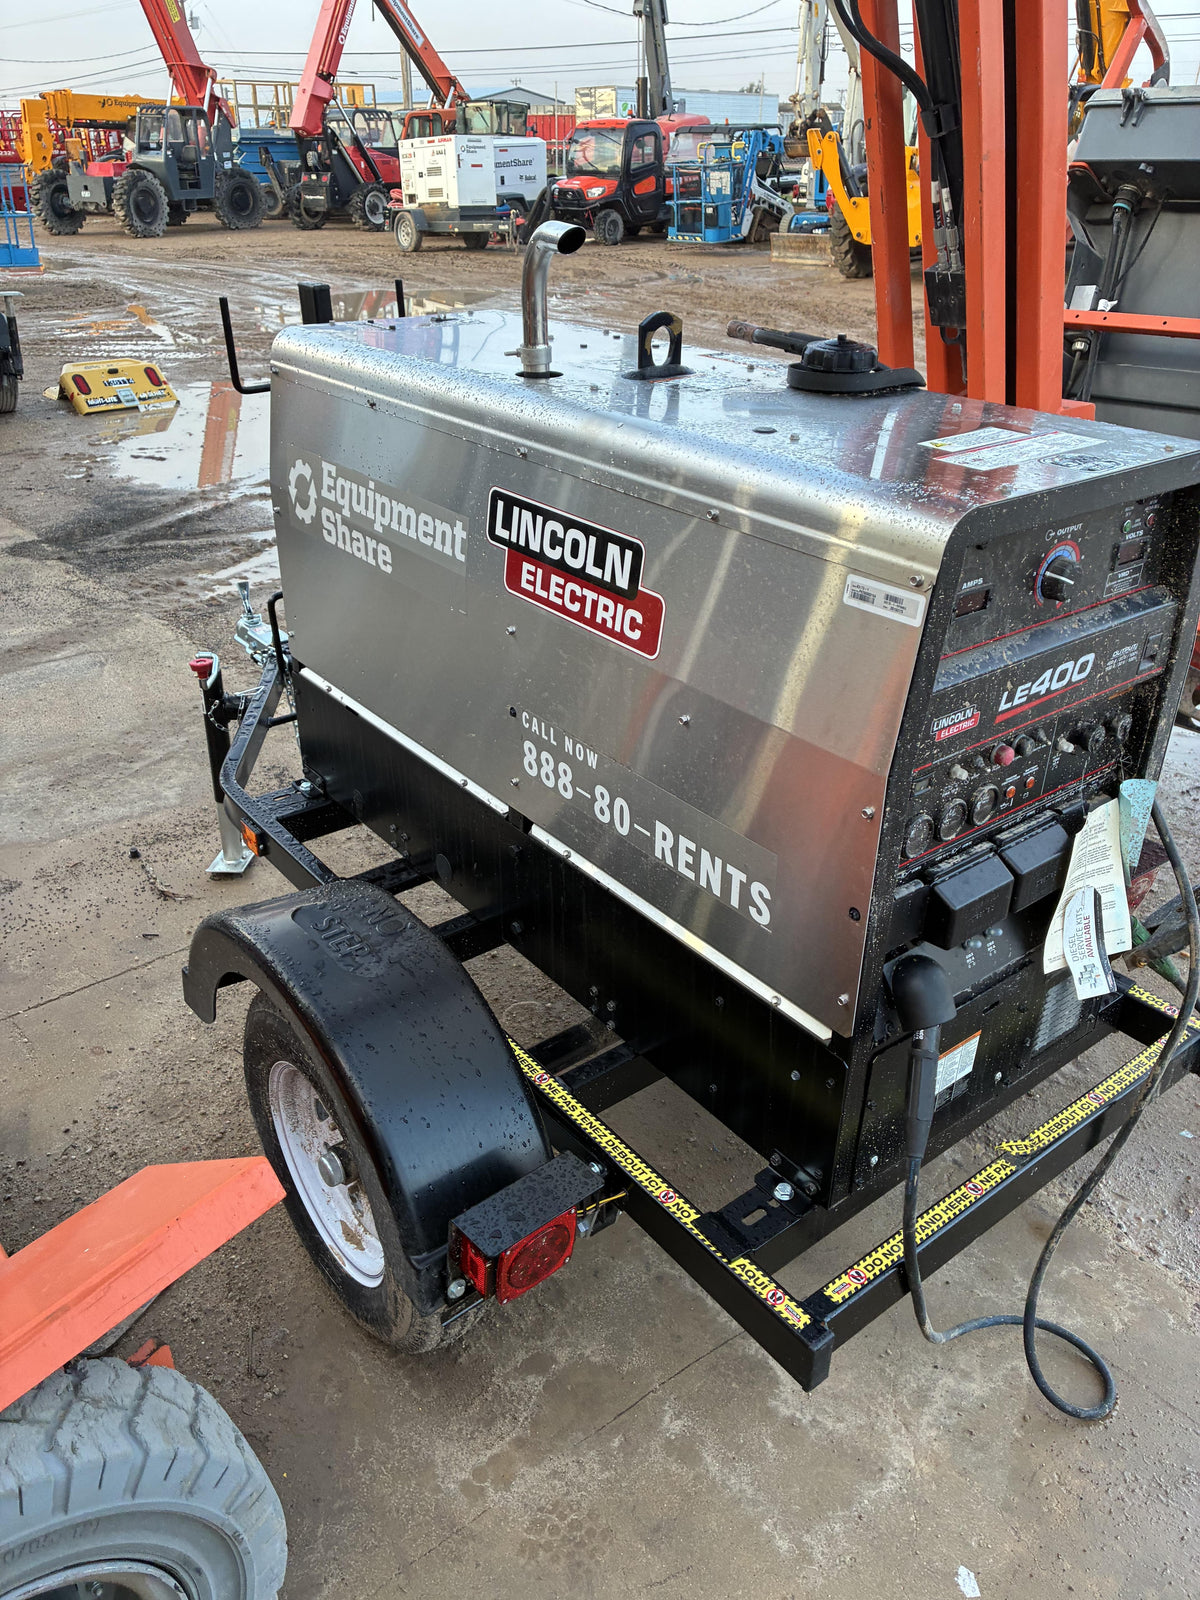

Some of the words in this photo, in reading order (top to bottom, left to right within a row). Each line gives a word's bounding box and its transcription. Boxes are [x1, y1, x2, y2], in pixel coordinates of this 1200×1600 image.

[321, 460, 467, 563] Equipment
[1057, 523, 1083, 536] OUTPUT
[321, 506, 393, 574] Share
[495, 499, 633, 590] LINCOLN
[1125, 529, 1143, 540] VOLTS
[520, 561, 643, 640] ELECTRIC
[961, 577, 984, 590] AMPS
[998, 653, 1096, 712] LE400
[522, 711, 557, 746] CALL
[933, 707, 974, 731] LINCOLN
[940, 718, 976, 738] ELECTRIC
[564, 735, 598, 770] NOW
[523, 740, 773, 926] 888-80-RENTS
[311, 915, 372, 958] STEP
[1076, 907, 1084, 926] KITS
[1083, 914, 1095, 958] AVAILABLE
[1069, 933, 1080, 962] DIESEL
[1076, 925, 1088, 961] SERVICE
[1041, 1111, 1081, 1138] DEBOUT
[1079, 1101, 1093, 1113] ICI
[1100, 1083, 1116, 1097] NO
[1112, 1075, 1128, 1087] SE
[1123, 1059, 1148, 1078] PARE
[514, 1053, 540, 1076] HERE
[544, 1082, 560, 1095] NE
[559, 1094, 578, 1113] PAS
[576, 1111, 606, 1141] TENEZ
[604, 1138, 649, 1180] DEBOUT
[644, 1177, 662, 1191] ICI
[672, 1202, 692, 1219] NO
[862, 1255, 885, 1274] DO
[914, 1213, 943, 1236] TAND
[940, 1191, 972, 1214] HERE
[978, 1172, 997, 1187] NE
[993, 1160, 1010, 1176] PA
